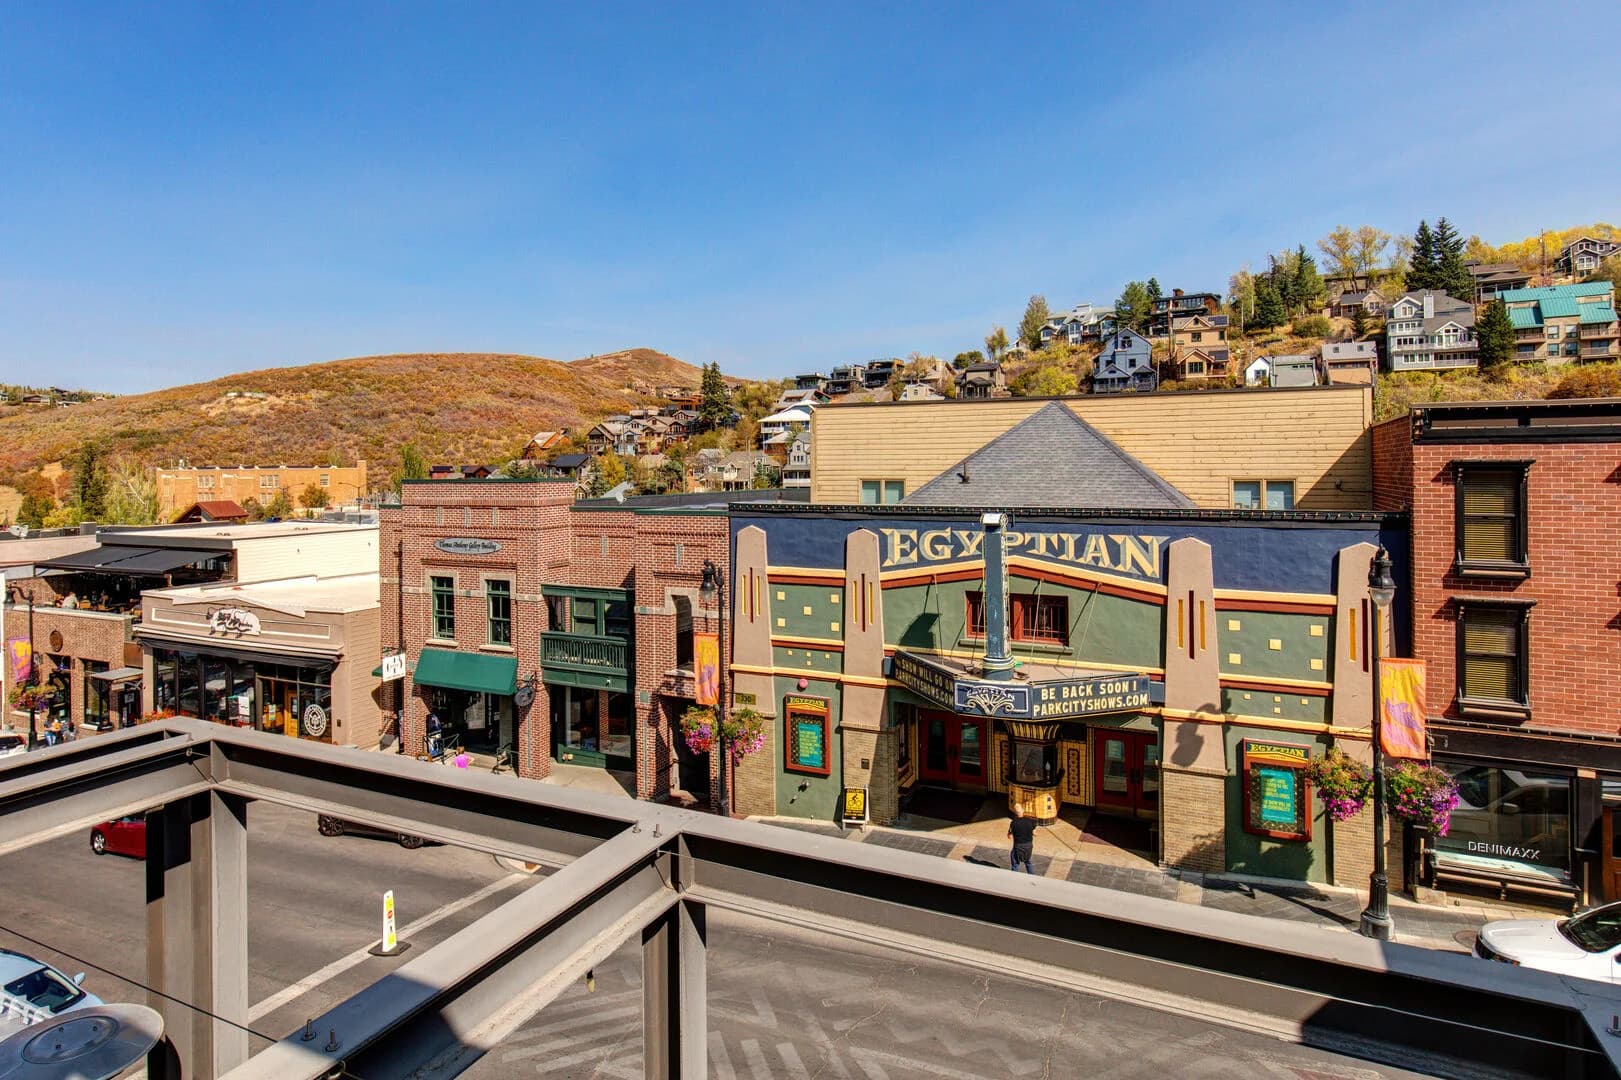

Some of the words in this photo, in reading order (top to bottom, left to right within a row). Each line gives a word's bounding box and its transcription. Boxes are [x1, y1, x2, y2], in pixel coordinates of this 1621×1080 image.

[880, 527, 1171, 578] EGYPTIAN
[1041, 688, 1056, 700] BE
[1062, 685, 1093, 699] BACK
[1033, 693, 1149, 717] PARKCITYSHOWS.COM
[1250, 743, 1305, 757] EGYPTIAN
[1468, 841, 1541, 860] DENIMAXX
